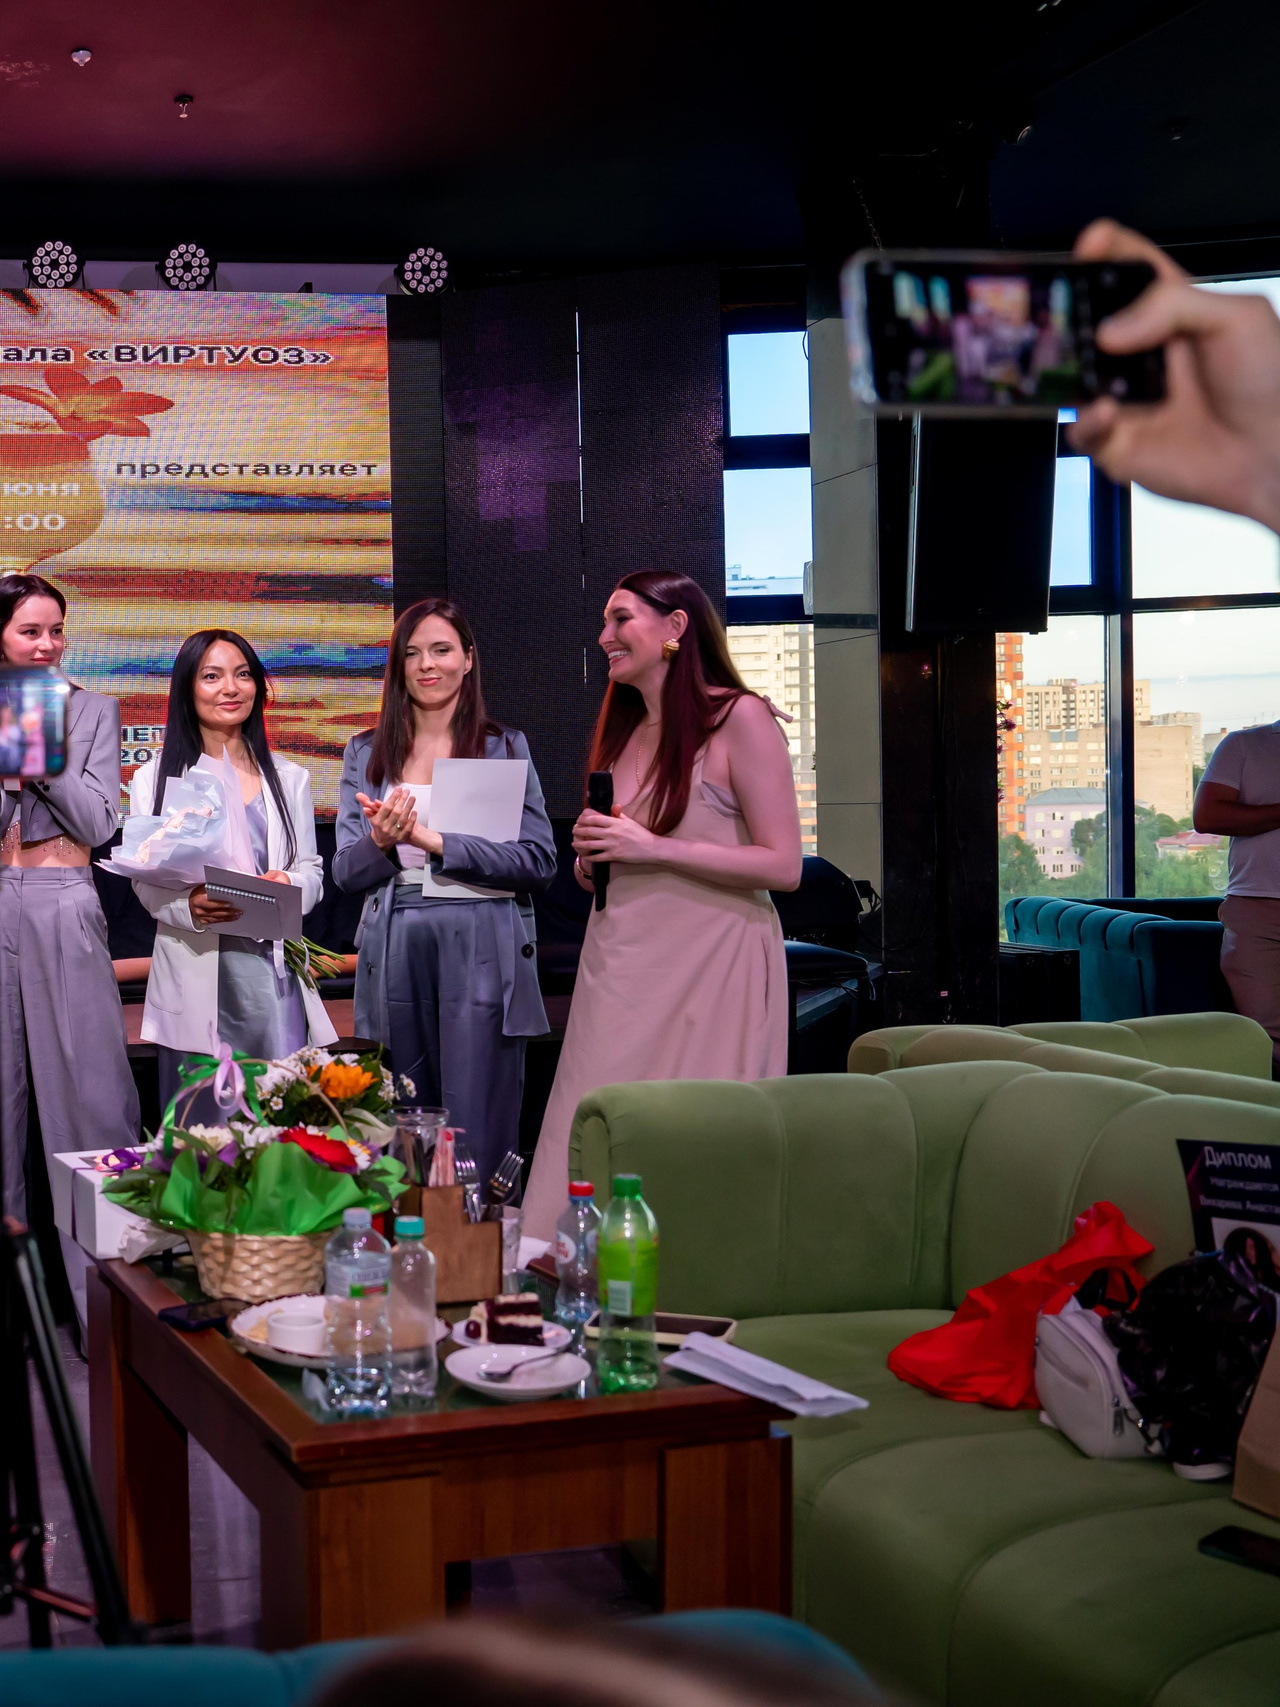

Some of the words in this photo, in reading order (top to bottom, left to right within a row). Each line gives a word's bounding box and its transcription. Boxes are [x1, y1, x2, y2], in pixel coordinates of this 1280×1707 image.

[84, 343, 333, 365] «ВИРТУОЗ»
[116, 462, 377, 478] представляет
[1203, 1146, 1272, 1170] Диплом
